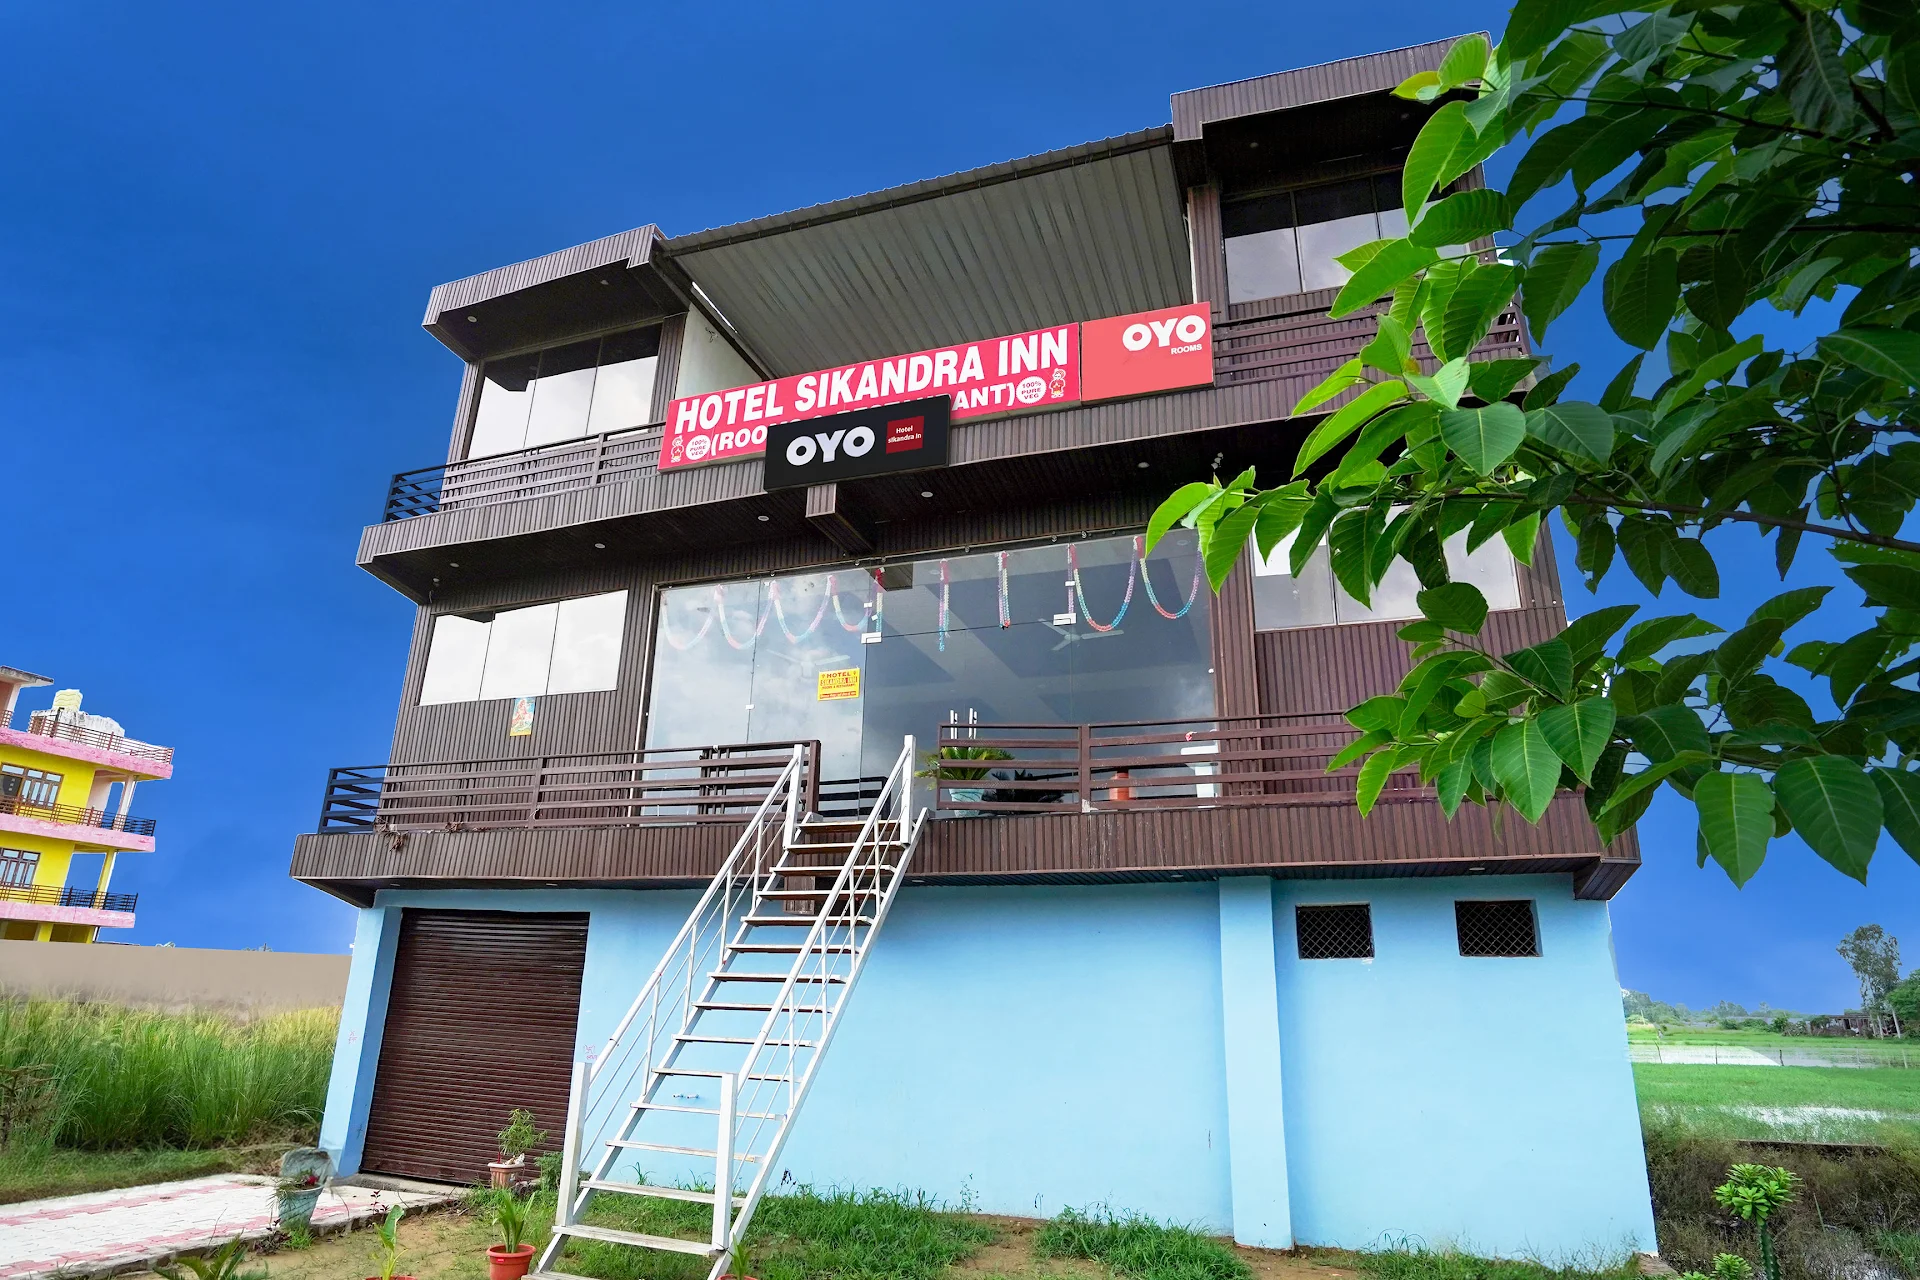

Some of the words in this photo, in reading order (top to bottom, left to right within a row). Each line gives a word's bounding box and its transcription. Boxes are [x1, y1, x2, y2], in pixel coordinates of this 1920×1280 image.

[1122, 315, 1206, 351] OYO
[1171, 344, 1202, 355] ROOMS
[675, 383, 784, 434] HOTEL
[794, 346, 985, 412] SIKANDRA
[998, 329, 1068, 377] INN
[1022, 380, 1041, 389] 100%
[1021, 387, 1041, 395] PURE
[895, 425, 913, 434] Hotel
[786, 426, 875, 466] OYO
